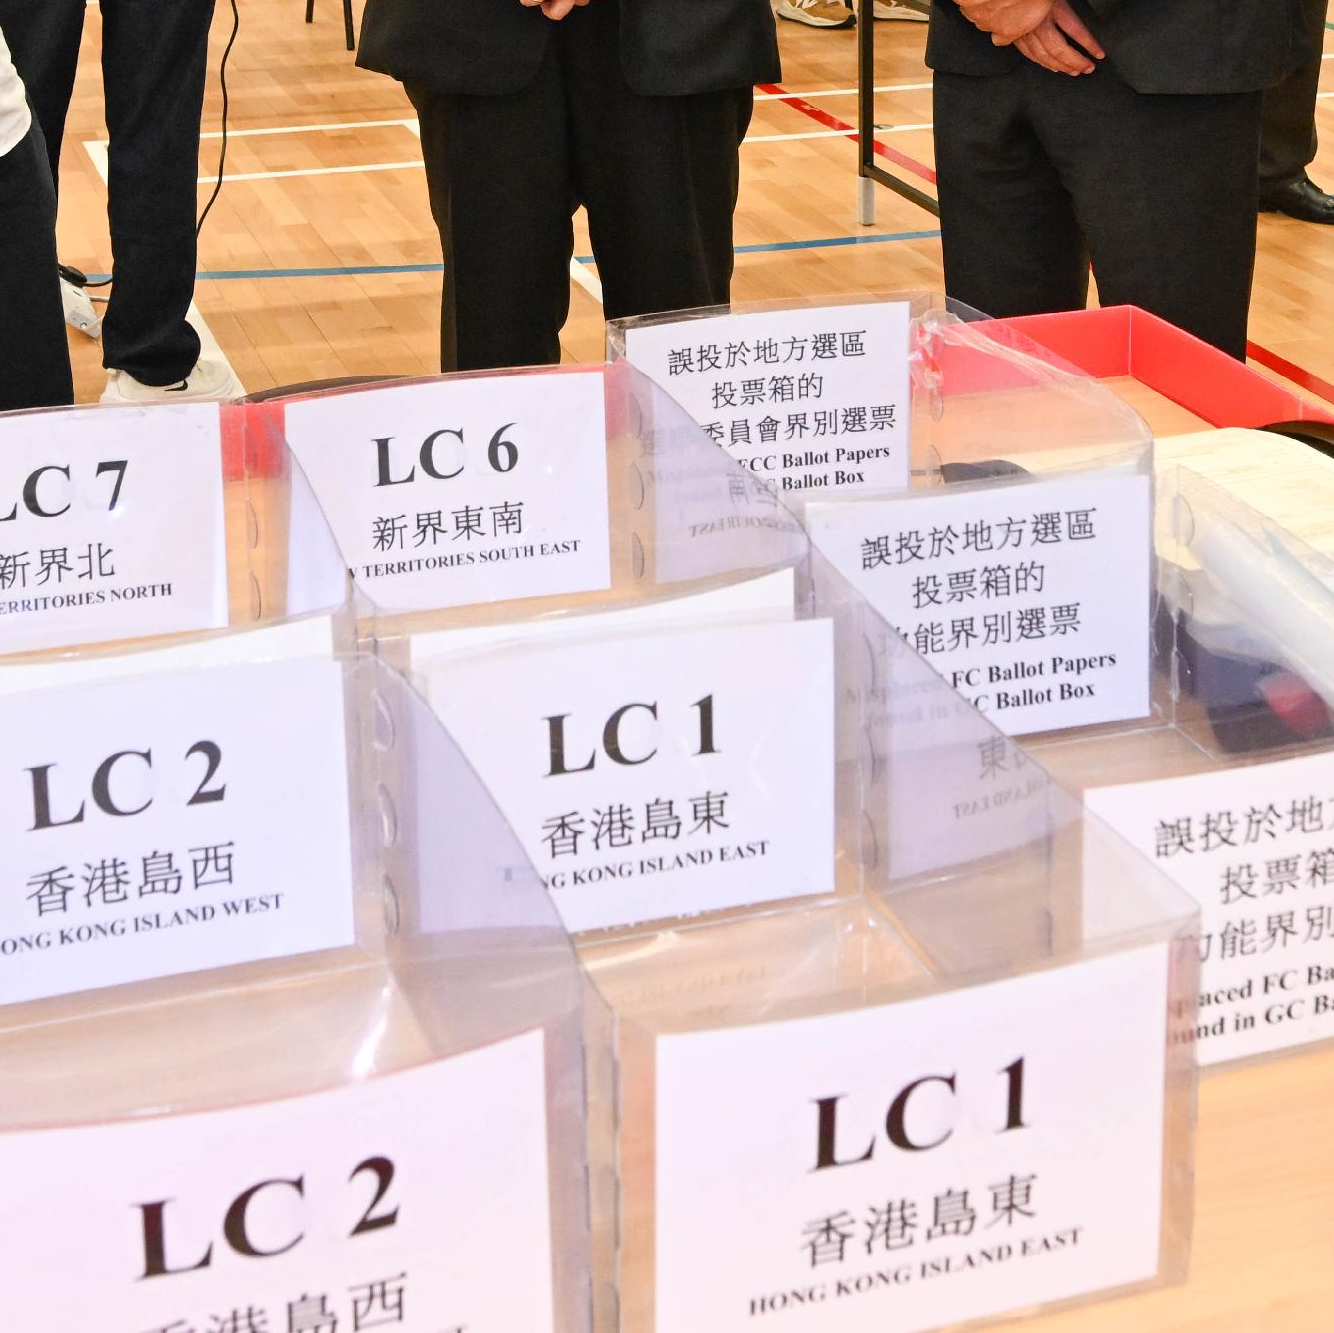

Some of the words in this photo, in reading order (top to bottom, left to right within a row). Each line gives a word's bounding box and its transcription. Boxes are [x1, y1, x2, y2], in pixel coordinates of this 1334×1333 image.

[668, 330, 866, 377] 誤投於地方選區
[711, 373, 823, 409] 投票箱的
[371, 427, 465, 487] LC
[487, 422, 518, 473] 6
[781, 451, 830, 469] Ballot
[835, 445, 891, 464] Papers
[781, 472, 830, 491] Ballot
[835, 468, 865, 485] Box
[94, 460, 129, 512] 7
[372, 501, 524, 552] 新界東南
[861, 507, 1098, 569] 誤投於地方選區
[362, 552, 475, 578] TERRITORIES
[479, 544, 535, 563] SOUTH
[540, 539, 581, 556] EAST
[110, 583, 173, 601] NORTH
[912, 561, 1045, 609] 投票箱的
[894, 603, 1081, 657] 能界別選票
[951, 668, 982, 690] FC
[988, 661, 1045, 684] Ballot
[1052, 651, 1117, 679] Papers
[996, 689, 1052, 710] Ballot
[1060, 682, 1095, 700] Box
[541, 701, 658, 778] LC
[690, 693, 723, 756] 1
[23, 748, 154, 832] LC
[184, 739, 227, 806] 2
[541, 790, 731, 859] 香港島東
[26, 841, 235, 918] 香港島西
[572, 861, 634, 885] KONG
[639, 848, 714, 874] ISLAND
[719, 839, 770, 861] EAST
[59, 919, 126, 946] KONG
[133, 904, 216, 933] ISLAND
[224, 893, 284, 917] WEST
[1263, 970, 1298, 994] FC
[1234, 1012, 1256, 1032] in
[1265, 999, 1306, 1024] GC
[807, 1071, 958, 1173] LC
[995, 1055, 1033, 1134] 1
[130, 1174, 305, 1282] LC
[347, 1155, 402, 1239] 2
[799, 1173, 1040, 1270] 香港島東
[749, 1285, 827, 1317] HONG
[835, 1266, 913, 1295] KONG
[920, 1246, 1013, 1279] ISLAND
[1020, 1227, 1084, 1256] EAST
[136, 1271, 407, 1333] 島西
